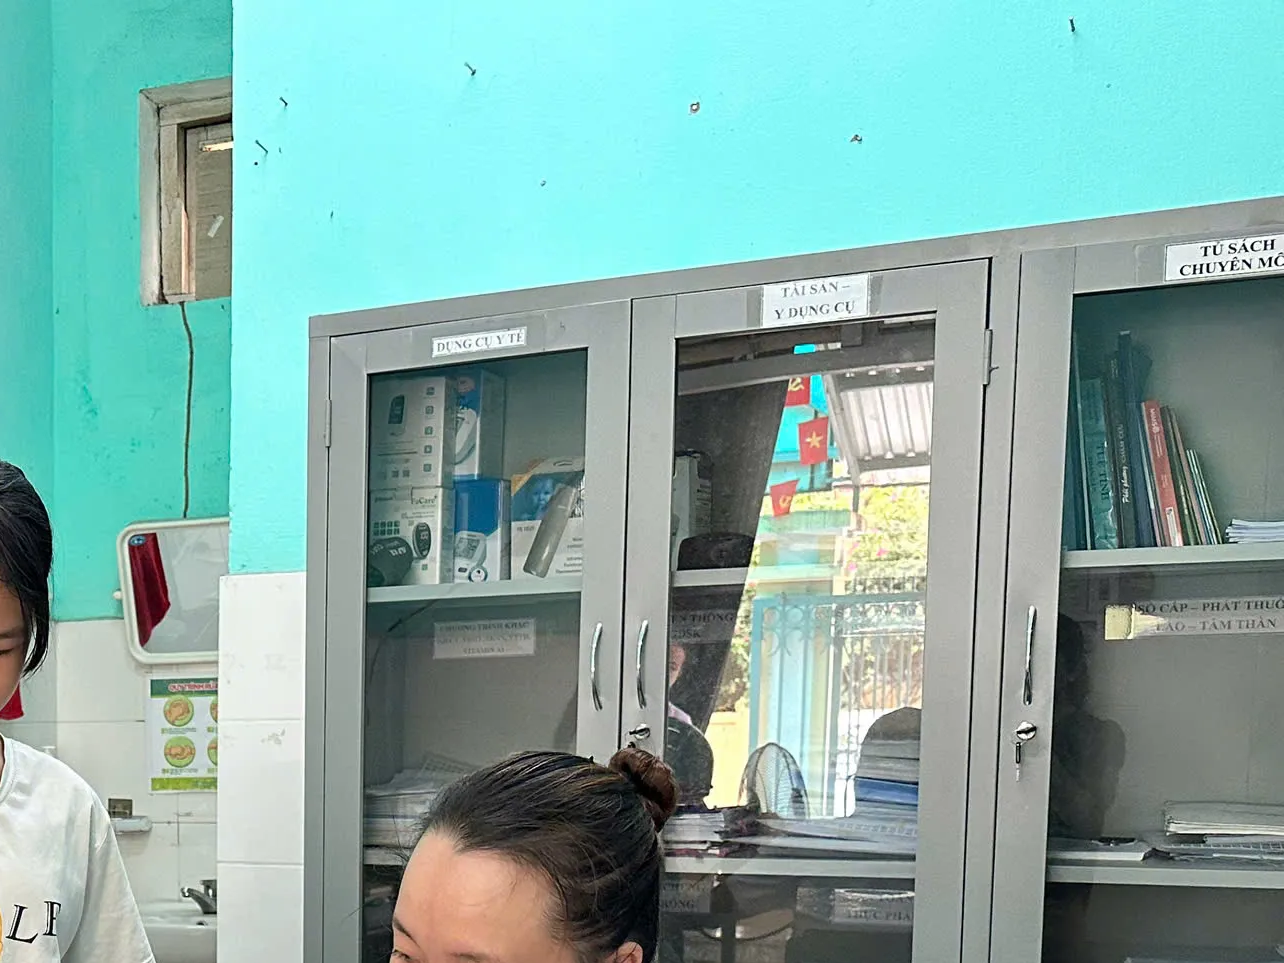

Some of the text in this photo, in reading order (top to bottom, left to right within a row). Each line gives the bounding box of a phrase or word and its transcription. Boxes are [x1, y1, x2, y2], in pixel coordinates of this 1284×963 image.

[1200, 238, 1275, 257] TỦ SÁCH
[1179, 257, 1253, 276] CHUYÊN
[774, 300, 855, 319] Y DỤNG CỤ
[437, 339, 472, 352] DỤNG
[475, 337, 493, 349] CỤ
[497, 334, 504, 344] Y
